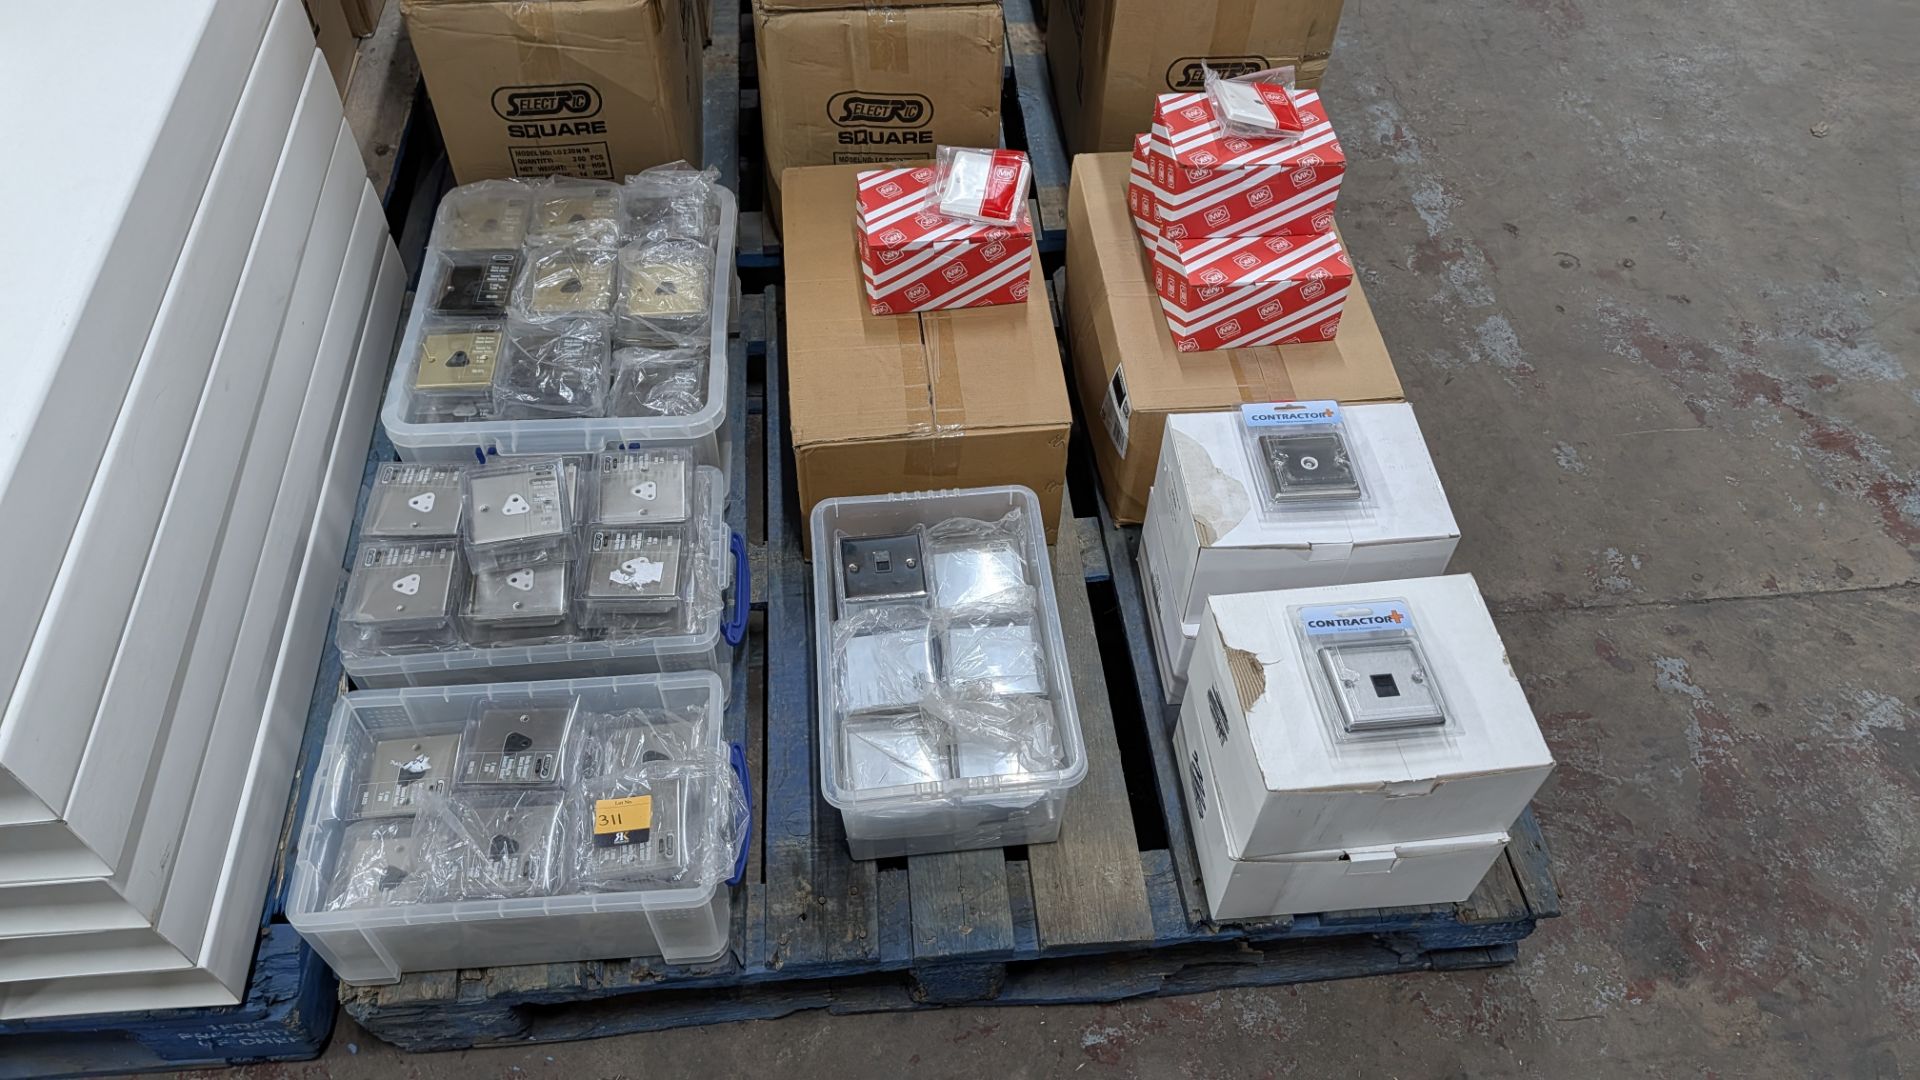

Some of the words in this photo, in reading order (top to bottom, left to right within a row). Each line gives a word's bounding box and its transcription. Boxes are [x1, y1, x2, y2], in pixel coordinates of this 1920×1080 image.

[508, 121, 607, 138] SQUARE
[838, 130, 933, 145] SQUARE
[997, 168, 1015, 179] MK
[1294, 168, 1313, 182] MK
[1250, 189, 1269, 201] MK
[1208, 209, 1227, 221] MK
[599, 813, 622, 826] 311
